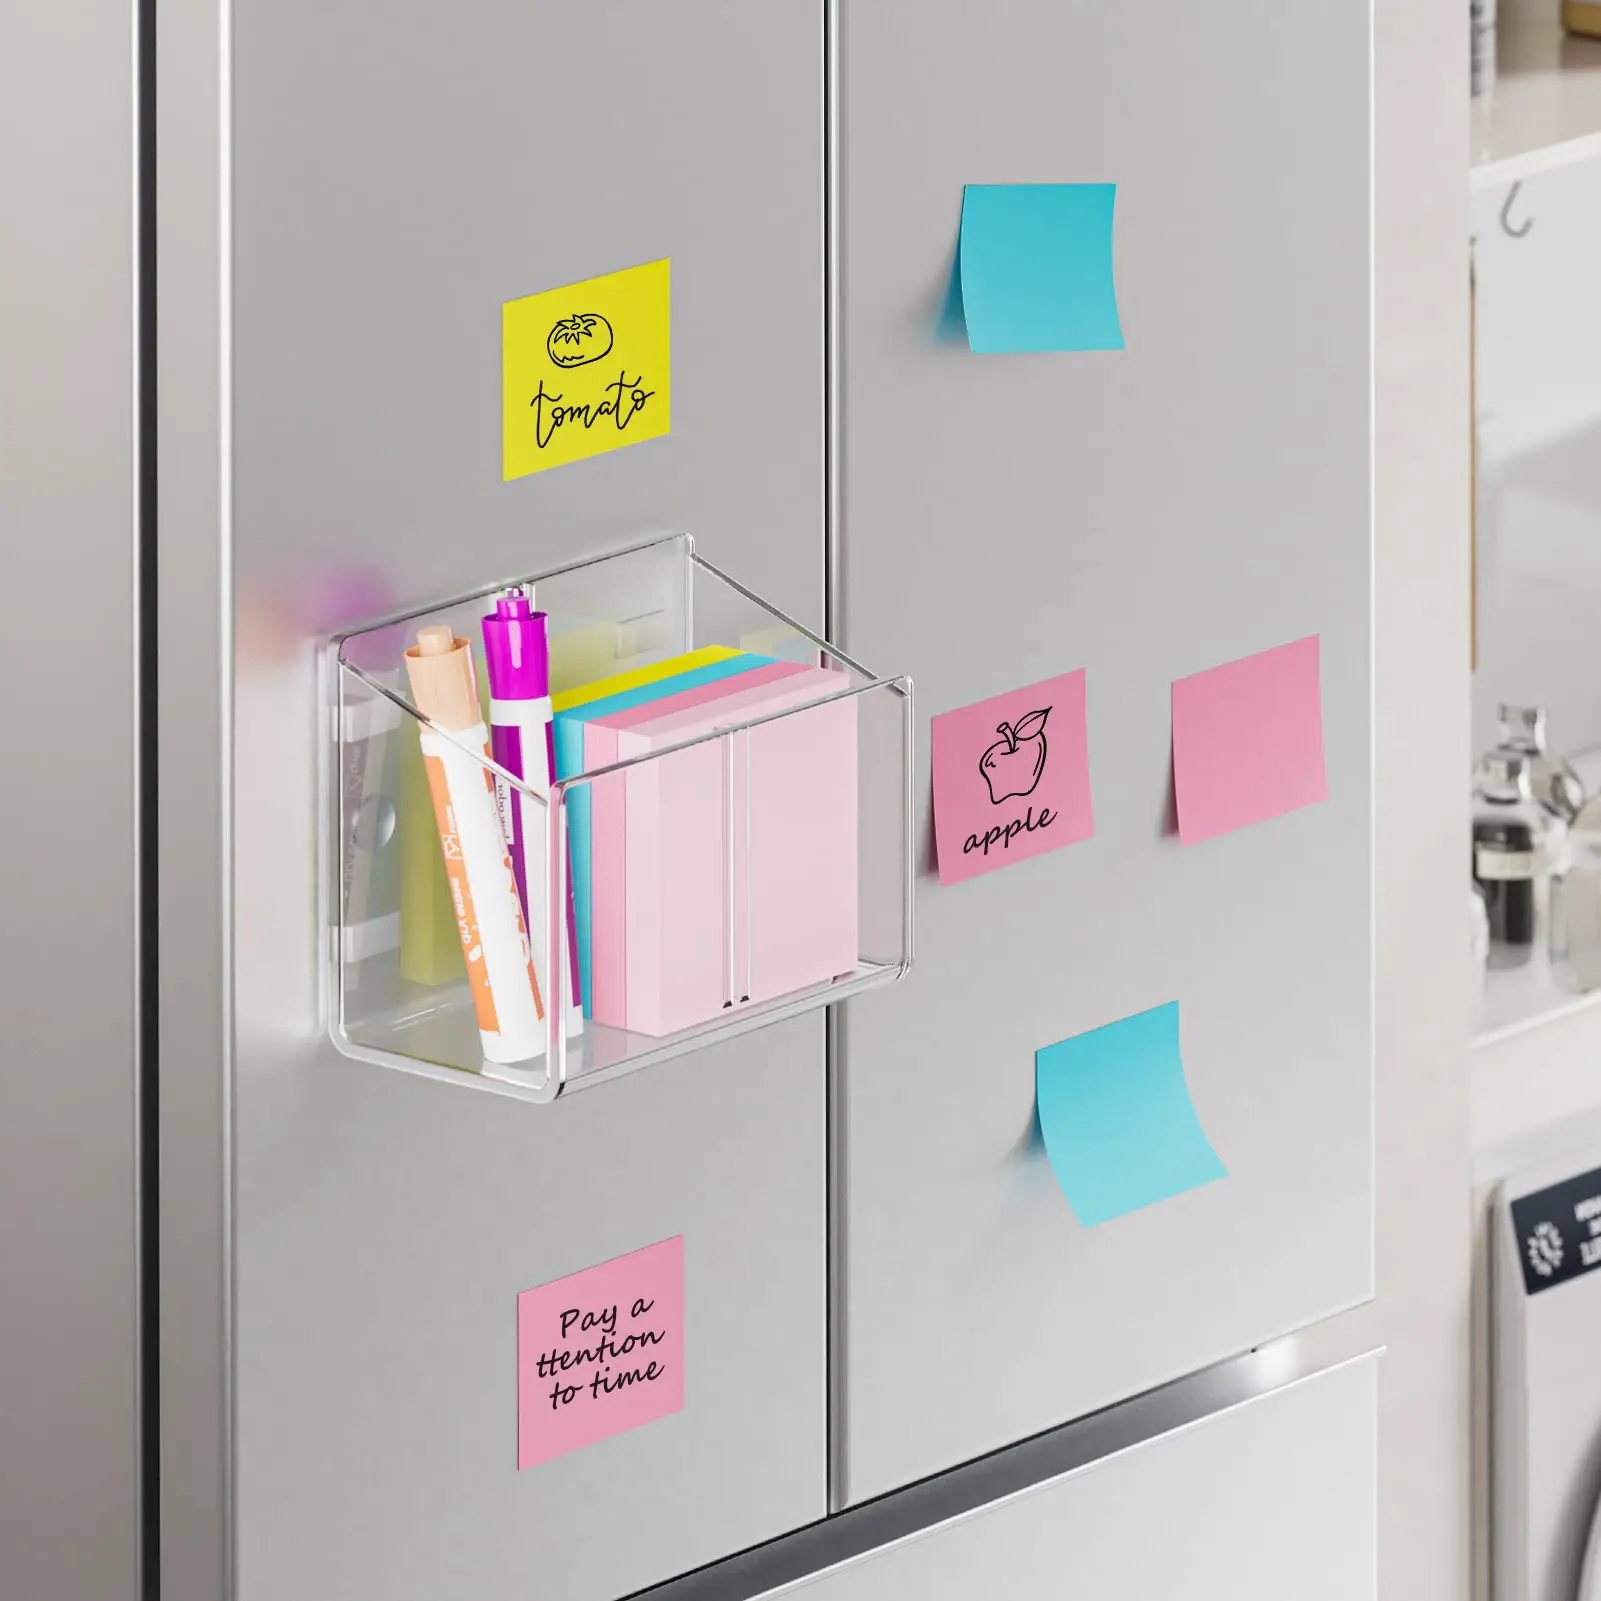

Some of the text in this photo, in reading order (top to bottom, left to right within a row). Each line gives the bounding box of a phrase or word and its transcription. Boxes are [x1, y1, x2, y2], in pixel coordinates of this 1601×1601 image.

[530, 370, 655, 448] tomato
[963, 806, 1059, 855] apple
[559, 1298, 655, 1339] Pay a
[536, 1330, 666, 1378] ttention
[549, 1361, 666, 1410] to time
